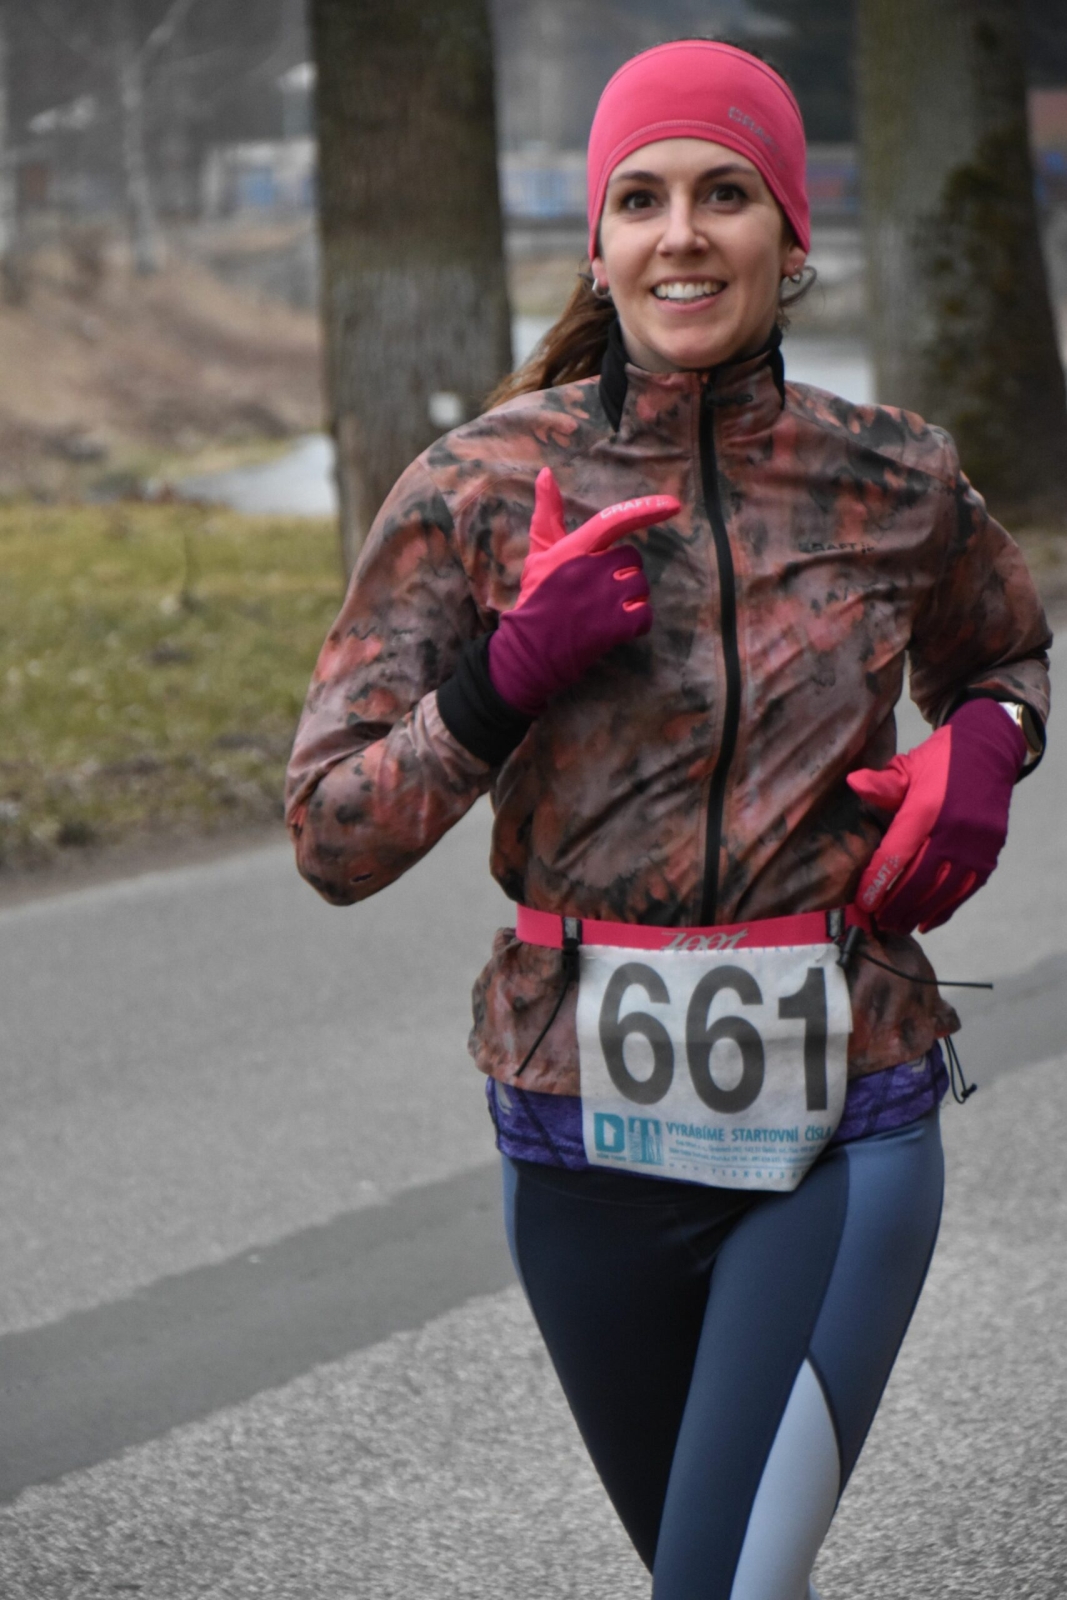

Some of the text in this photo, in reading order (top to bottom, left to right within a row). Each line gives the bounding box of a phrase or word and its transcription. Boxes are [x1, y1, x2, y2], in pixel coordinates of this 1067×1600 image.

[600, 498, 652, 519] CRAFT
[863, 864, 891, 906] CRAFT
[599, 962, 828, 1114] 661
[665, 1121, 725, 1141] VYRÁBÍME
[732, 1126, 799, 1142] STARTOVNÍ
